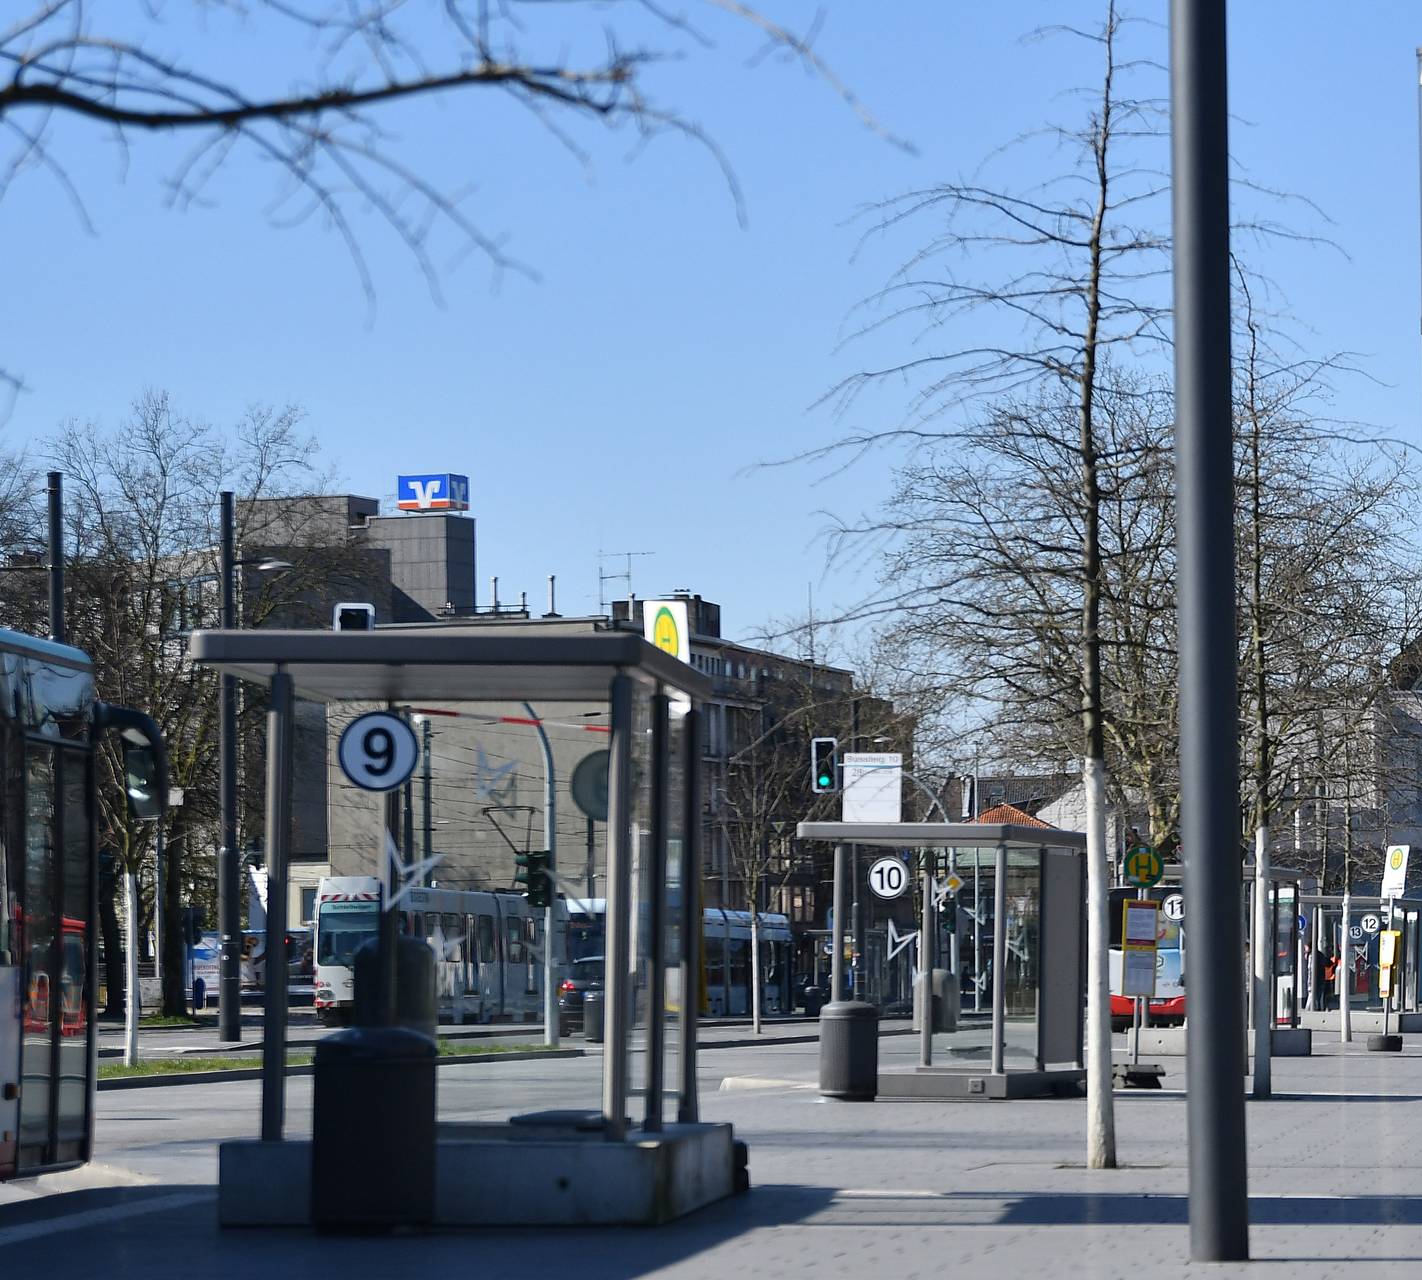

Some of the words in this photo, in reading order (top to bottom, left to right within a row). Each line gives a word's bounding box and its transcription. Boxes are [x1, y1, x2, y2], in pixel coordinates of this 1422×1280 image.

[363, 727, 396, 777] 9
[1135, 854, 1152, 878] H
[875, 866, 902, 890] 10
[1167, 899, 1185, 916] 11
[1351, 927, 1361, 937] 13
[1364, 918, 1377, 930] 12
